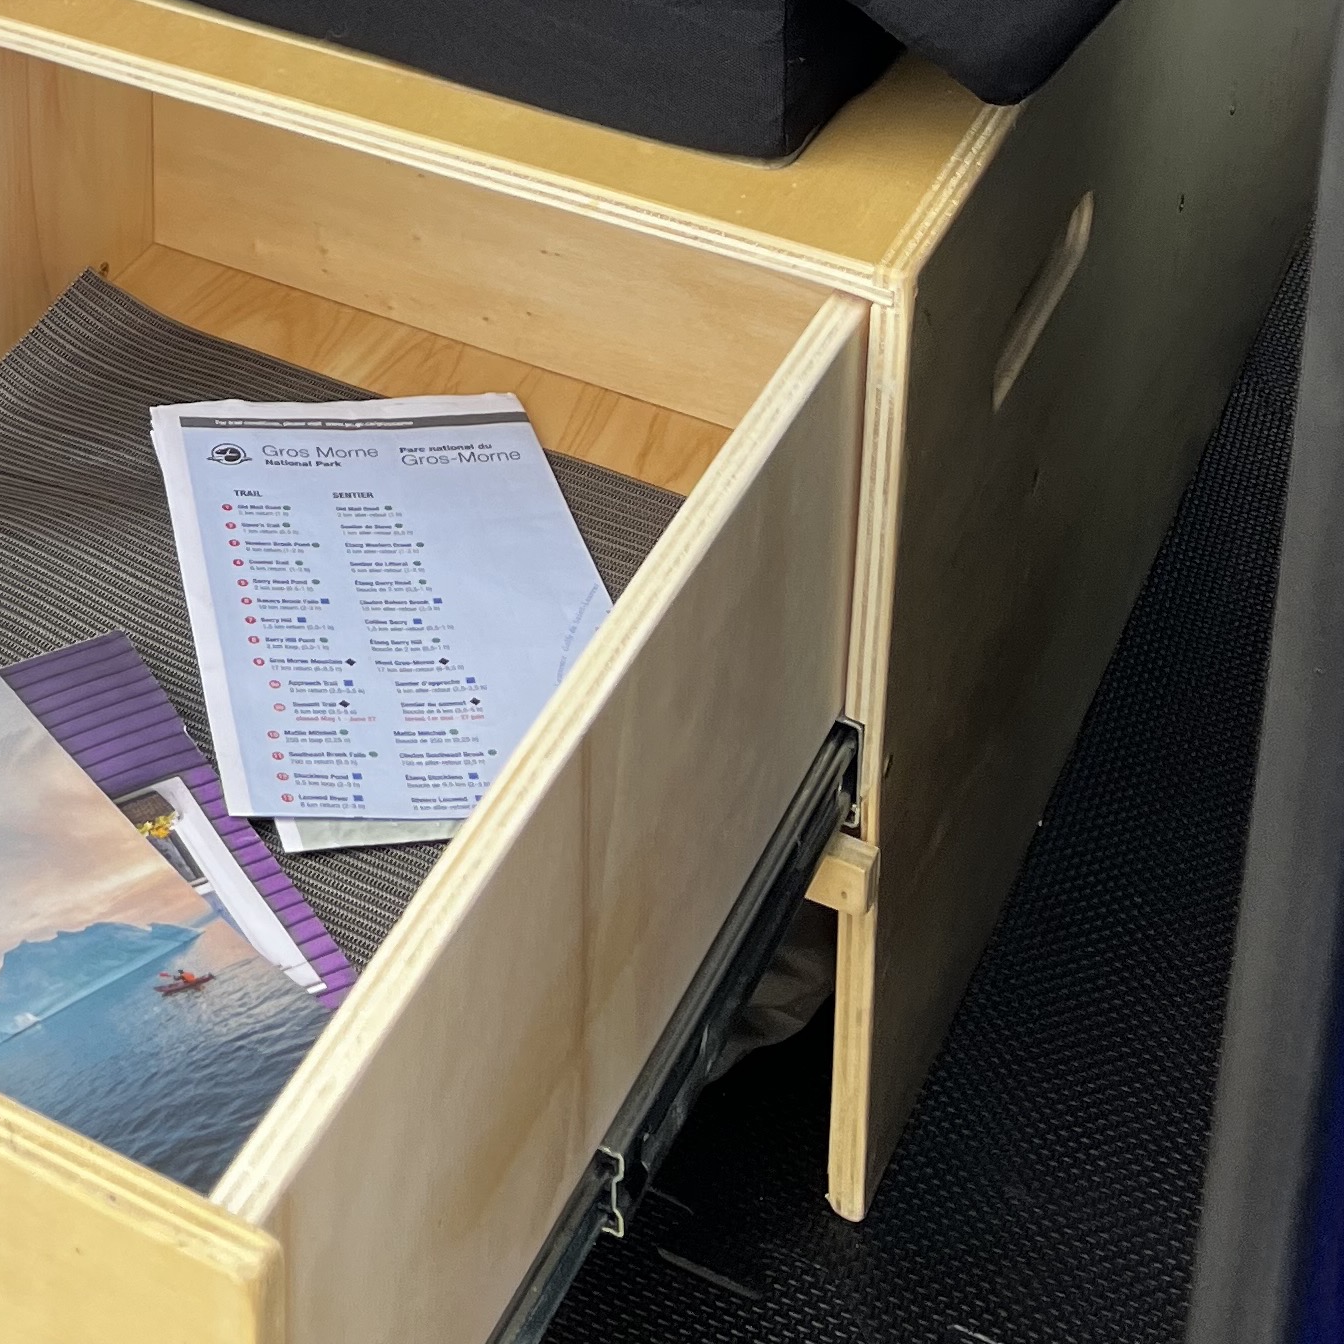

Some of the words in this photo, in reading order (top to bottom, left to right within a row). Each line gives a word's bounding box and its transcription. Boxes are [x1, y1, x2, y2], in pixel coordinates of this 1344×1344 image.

[262, 444, 310, 458] Gros
[317, 446, 379, 458] Morne
[429, 443, 474, 452] national
[265, 459, 312, 467] National
[401, 449, 521, 466] Gros-Morne
